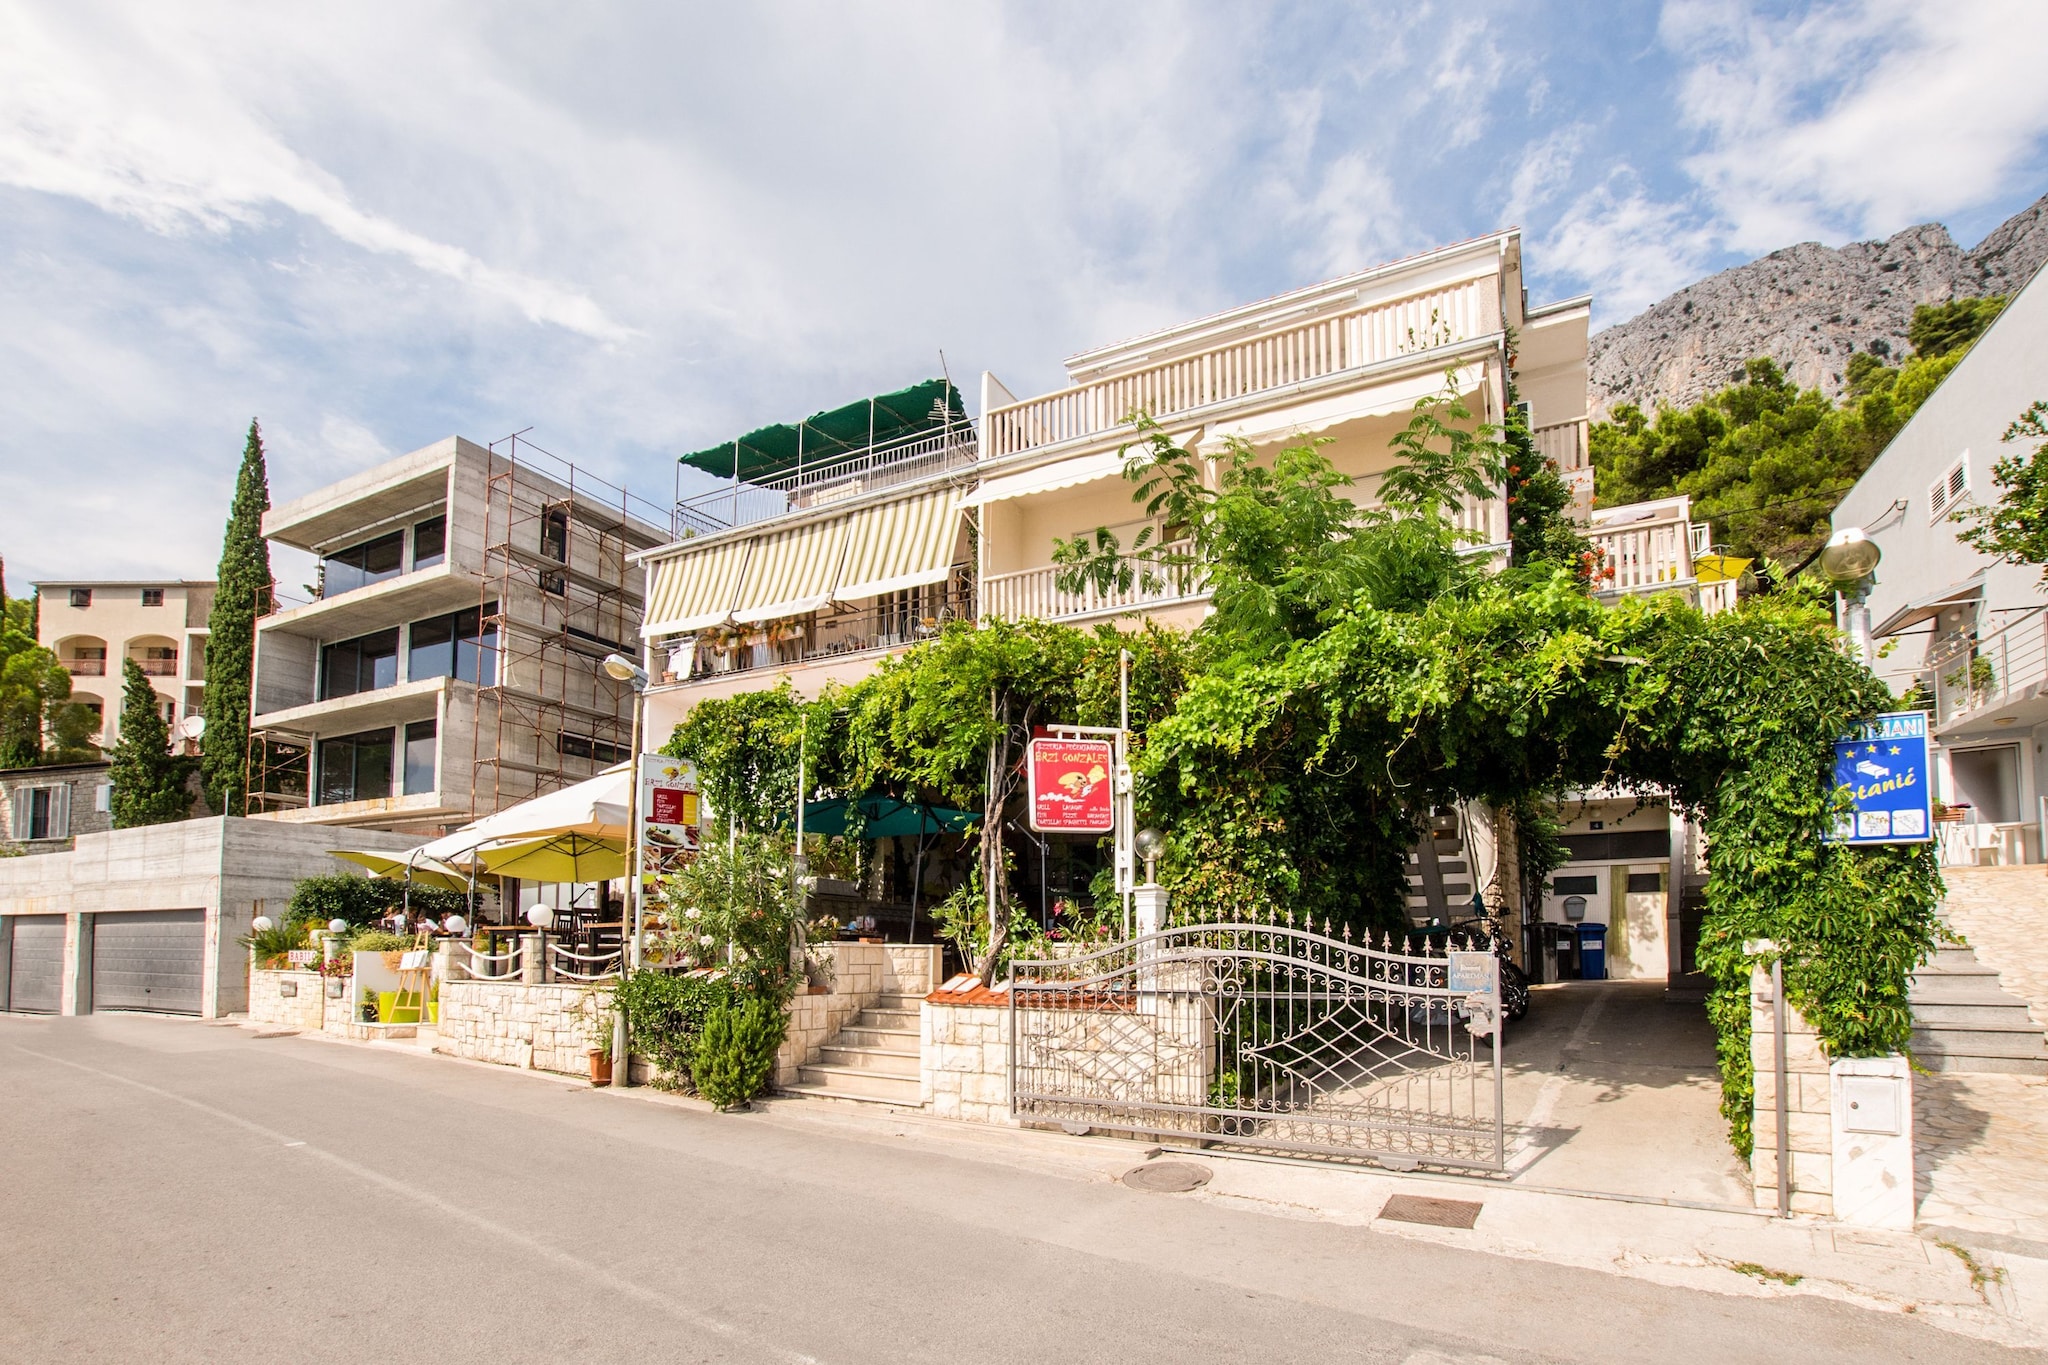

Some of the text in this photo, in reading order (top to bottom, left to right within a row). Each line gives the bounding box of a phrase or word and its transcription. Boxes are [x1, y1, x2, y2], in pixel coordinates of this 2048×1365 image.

[1035, 752, 1108, 764] BRZI GONZALES
[1834, 767, 1916, 811] Stanić
